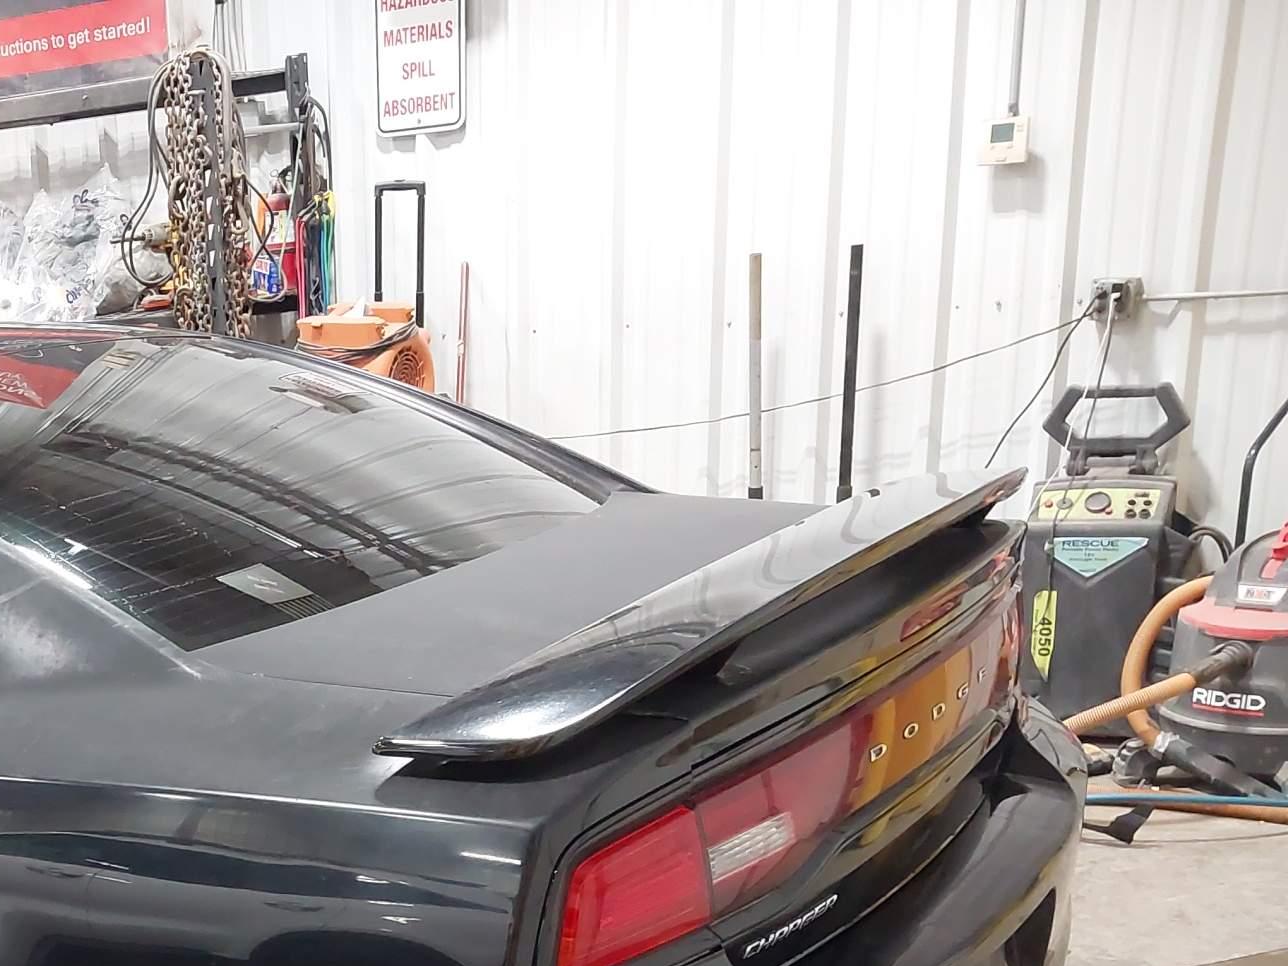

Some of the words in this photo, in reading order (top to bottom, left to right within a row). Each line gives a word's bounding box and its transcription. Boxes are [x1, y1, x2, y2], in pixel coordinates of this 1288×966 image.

[50, 35, 64, 48] to
[68, 28, 90, 49] get
[93, 16, 150, 41] started!
[383, 20, 453, 47] MATERIALS
[402, 59, 435, 80] SPILL
[383, 92, 455, 117] ABSORBENT
[1062, 539, 1119, 547] RESCUE
[1038, 617, 1052, 656] 4050
[1192, 687, 1266, 710] RIDGID
